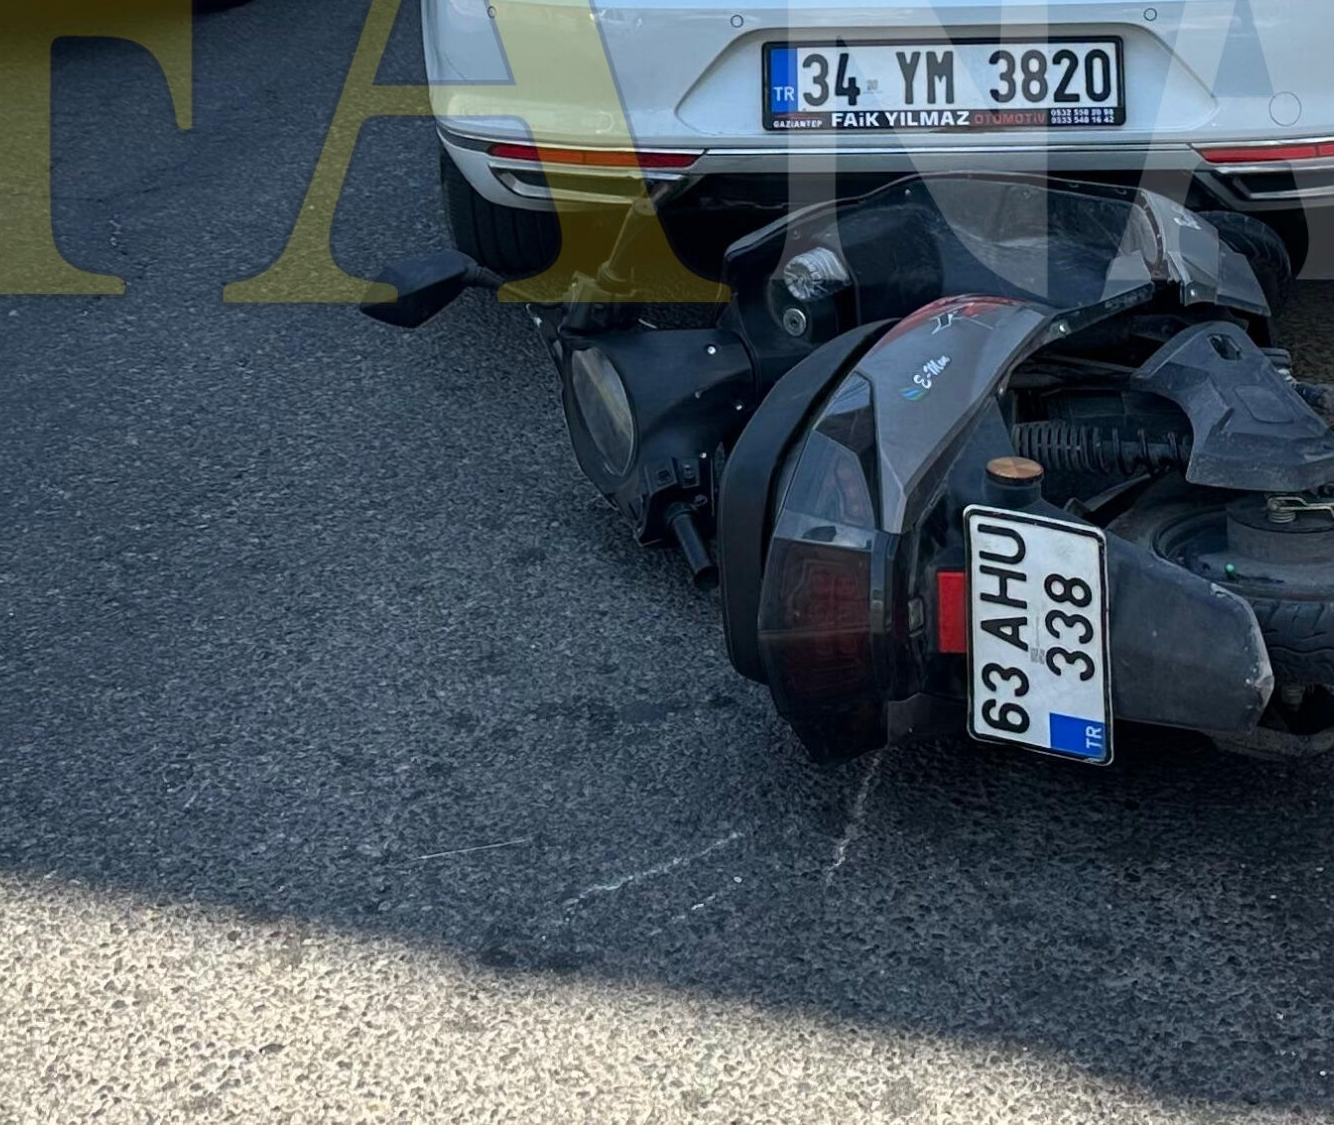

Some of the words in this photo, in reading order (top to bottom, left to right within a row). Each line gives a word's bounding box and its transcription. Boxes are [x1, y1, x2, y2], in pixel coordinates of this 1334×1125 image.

[773, 86, 795, 102] TR
[802, 53, 861, 106] 34
[895, 51, 955, 105] YM
[989, 49, 1111, 103] 3820
[885, 111, 970, 126] YILMAZ
[977, 523, 1029, 652] AHU
[1044, 573, 1095, 681] 338
[981, 662, 1030, 734] 63
[1086, 725, 1103, 749] TR
